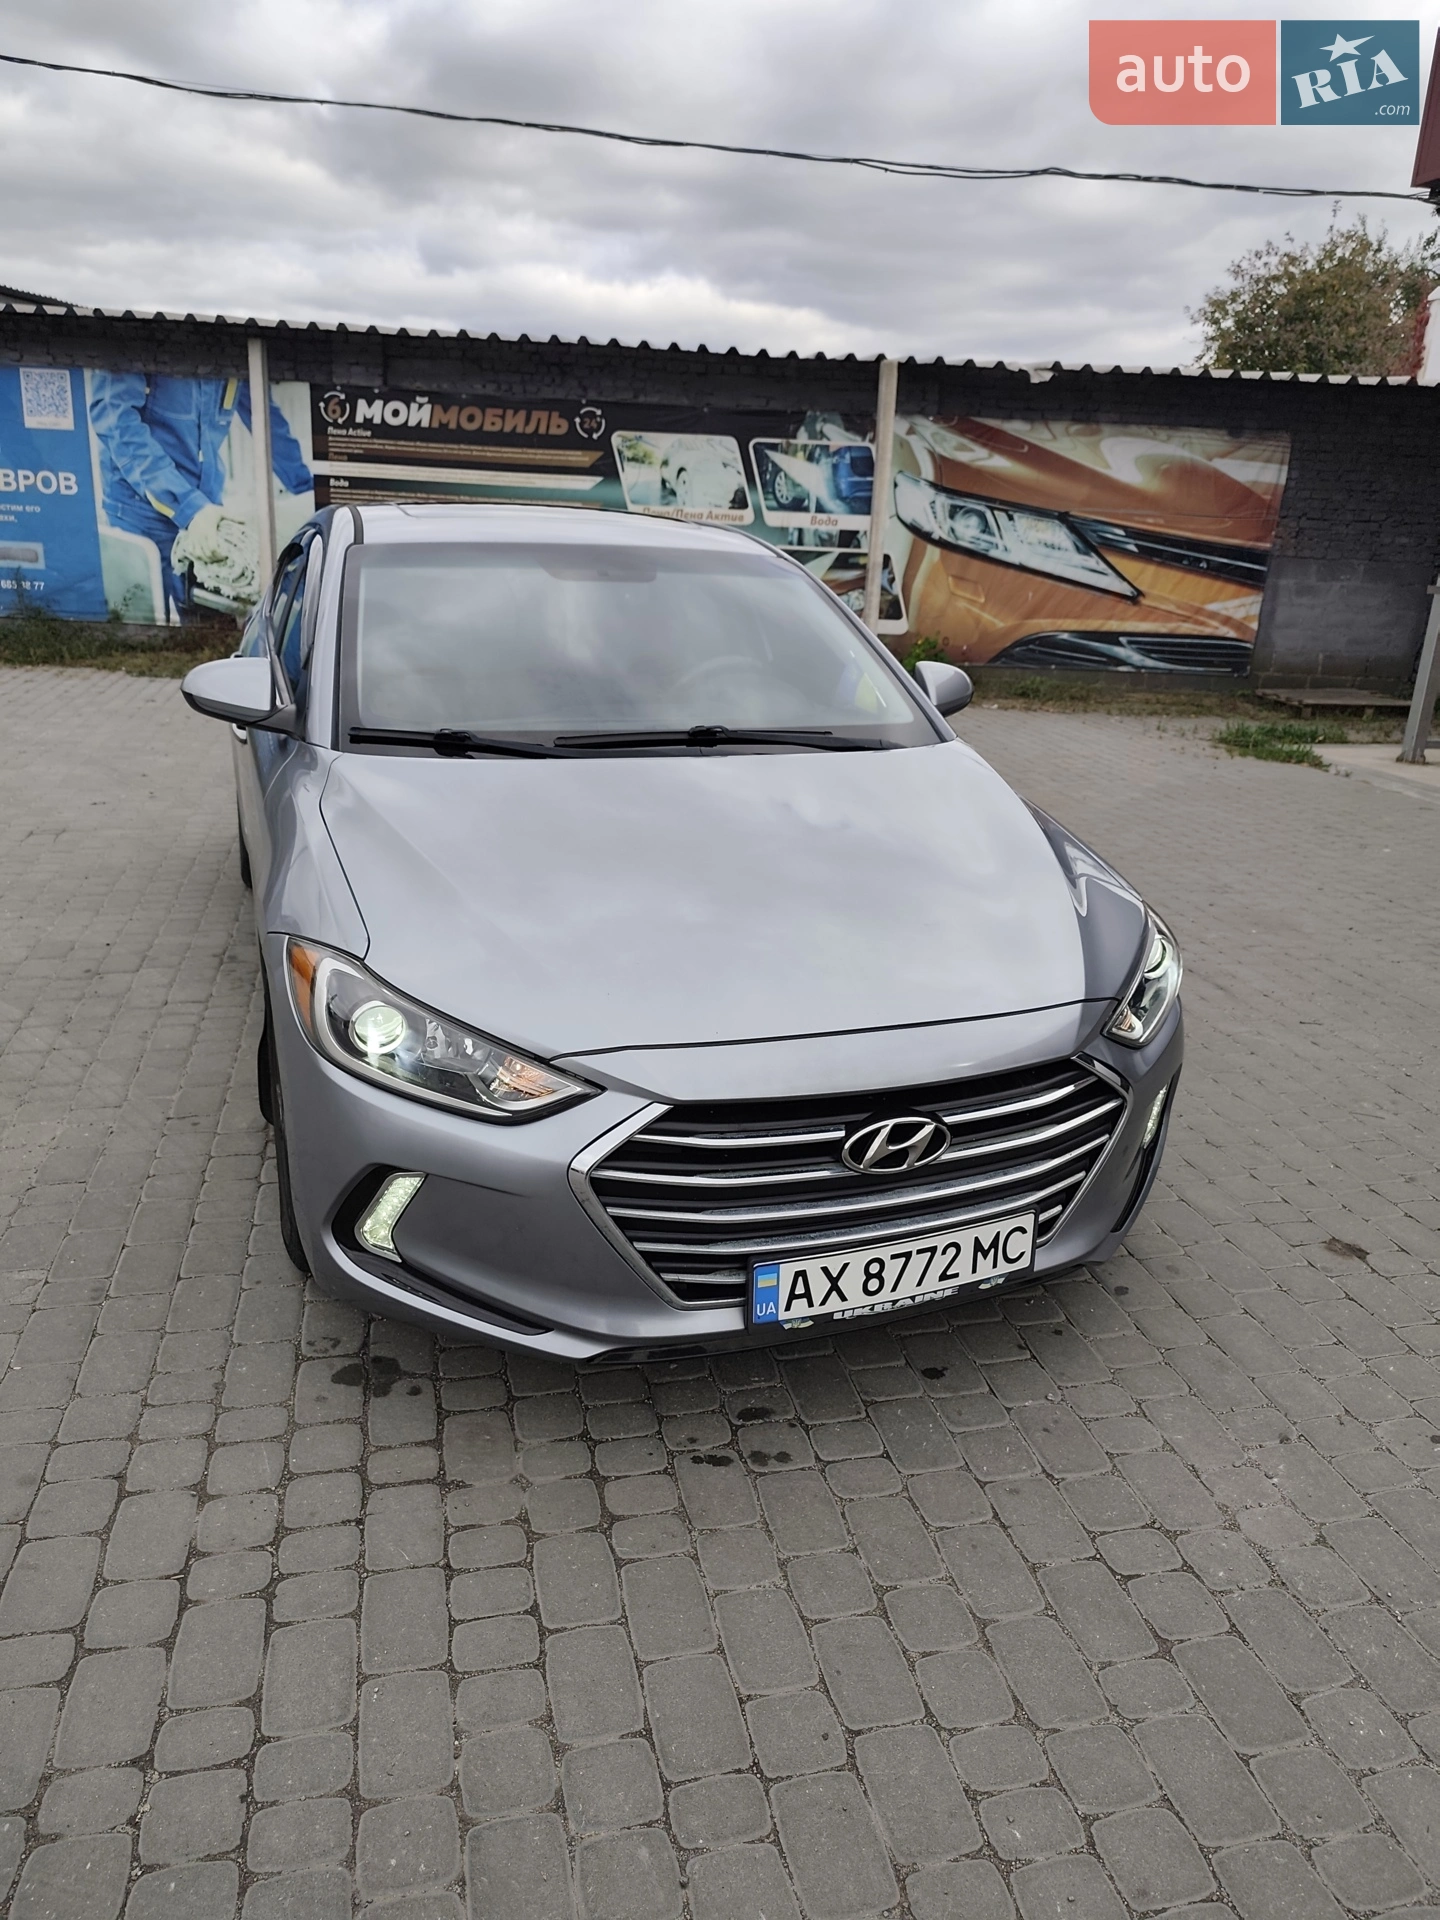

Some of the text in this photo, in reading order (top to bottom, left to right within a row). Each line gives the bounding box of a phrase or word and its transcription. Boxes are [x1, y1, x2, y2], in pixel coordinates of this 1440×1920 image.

[355, 396, 569, 435] МОЙМОБИЛЬ
[25, 505, 41, 513] его
[811, 515, 838, 526] Вода
[33, 581, 45, 591] 77
[784, 1226, 1028, 1313] AX 8772 MC
[757, 1302, 776, 1317] UA
[833, 1286, 960, 1320] UKRAINE
